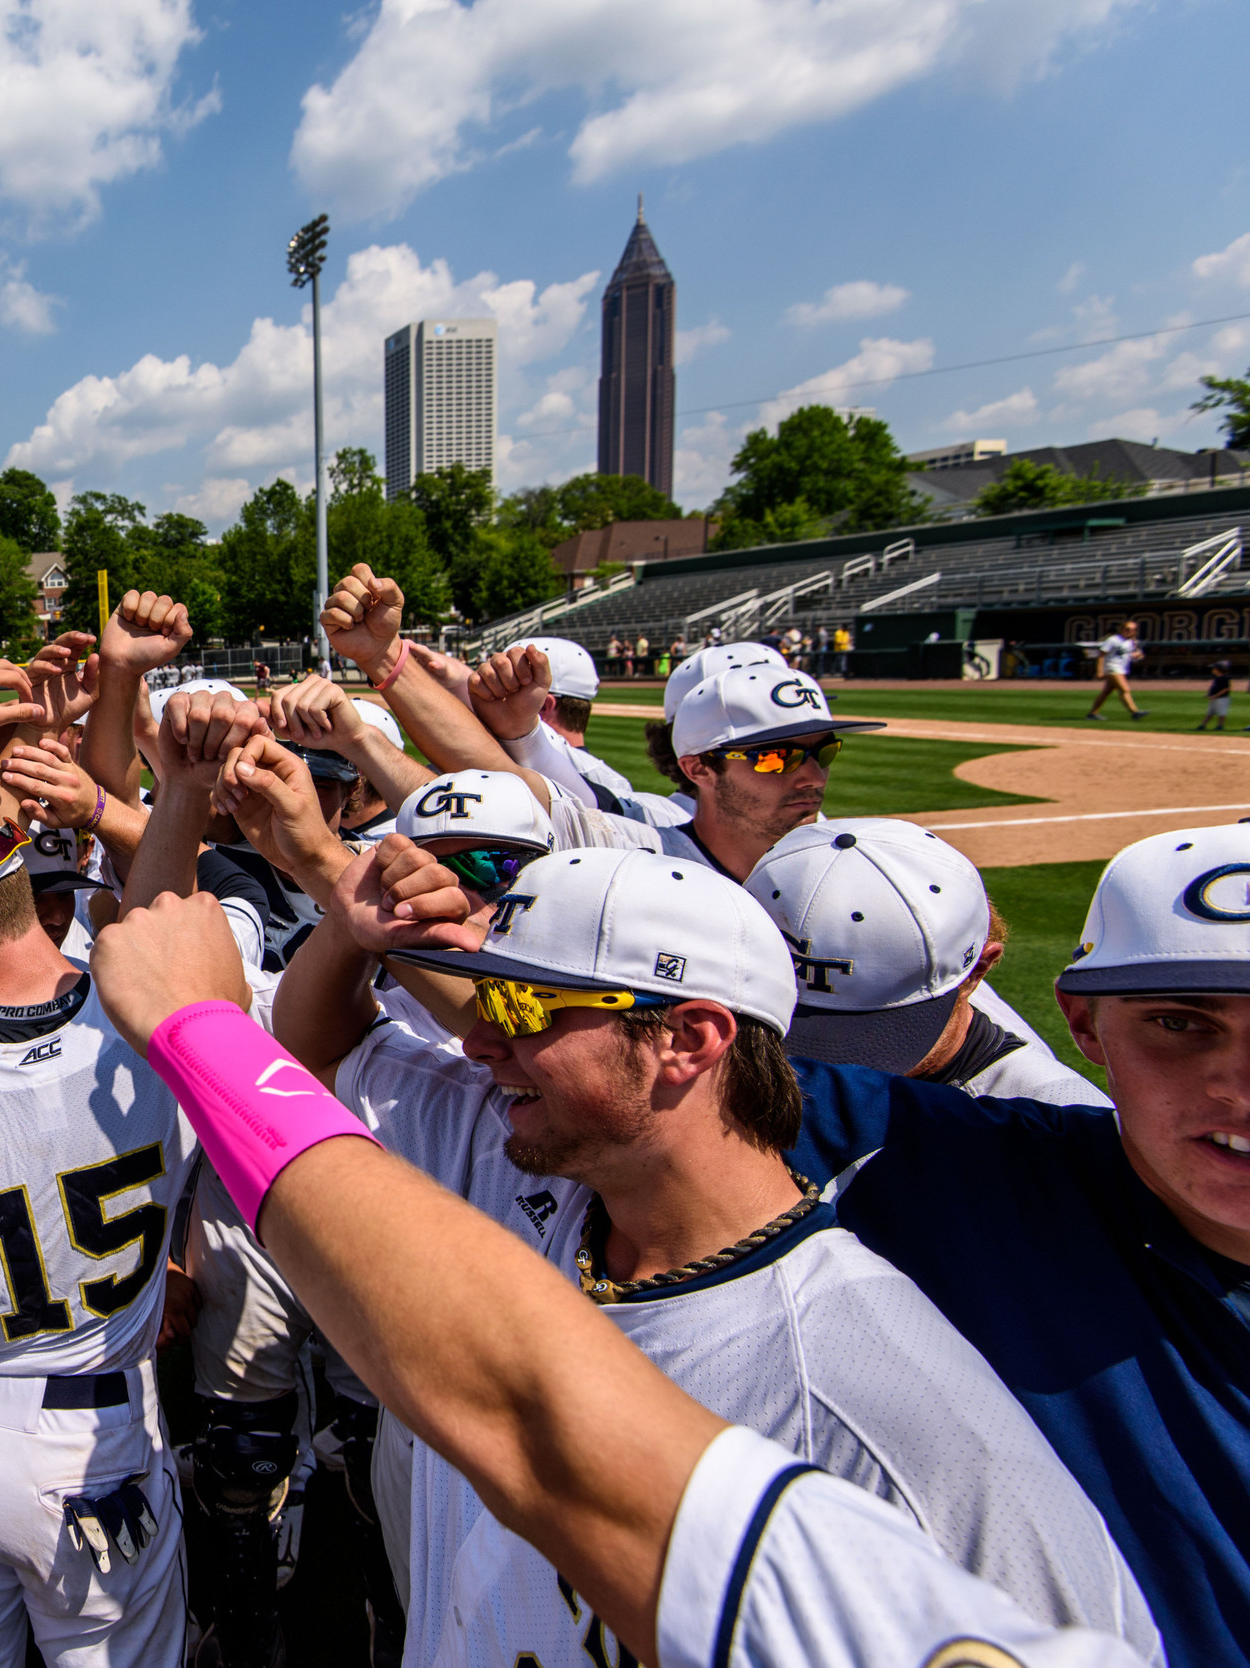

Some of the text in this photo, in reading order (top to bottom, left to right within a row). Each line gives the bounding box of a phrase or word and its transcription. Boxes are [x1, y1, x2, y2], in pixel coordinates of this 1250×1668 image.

[770, 678, 822, 709] GT
[415, 782, 483, 819] GT
[34, 829, 73, 861] GT
[26, 994, 75, 1018] COMBAT
[20, 1037, 62, 1064] ACC
[515, 1195, 547, 1239] RUSSELL
